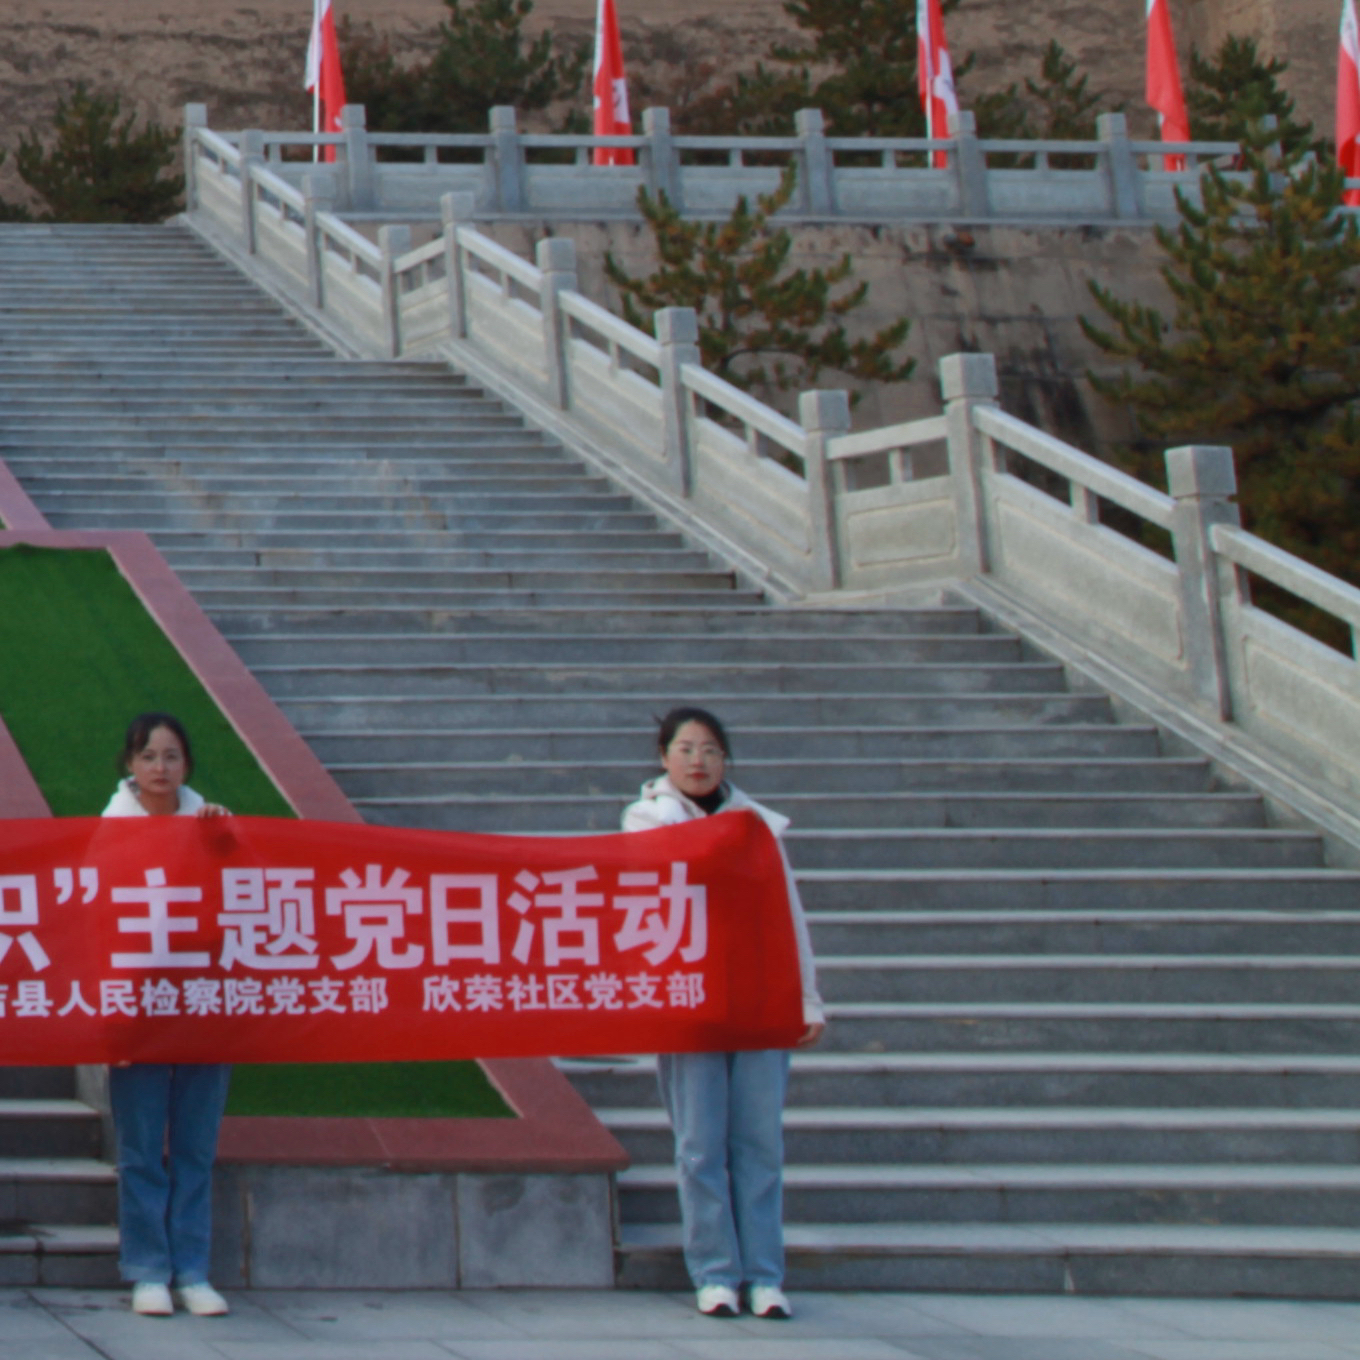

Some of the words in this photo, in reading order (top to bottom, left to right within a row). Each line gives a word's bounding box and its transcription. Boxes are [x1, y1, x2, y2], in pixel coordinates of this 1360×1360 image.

[422, 972, 706, 1012] 欣荣社区党支部
